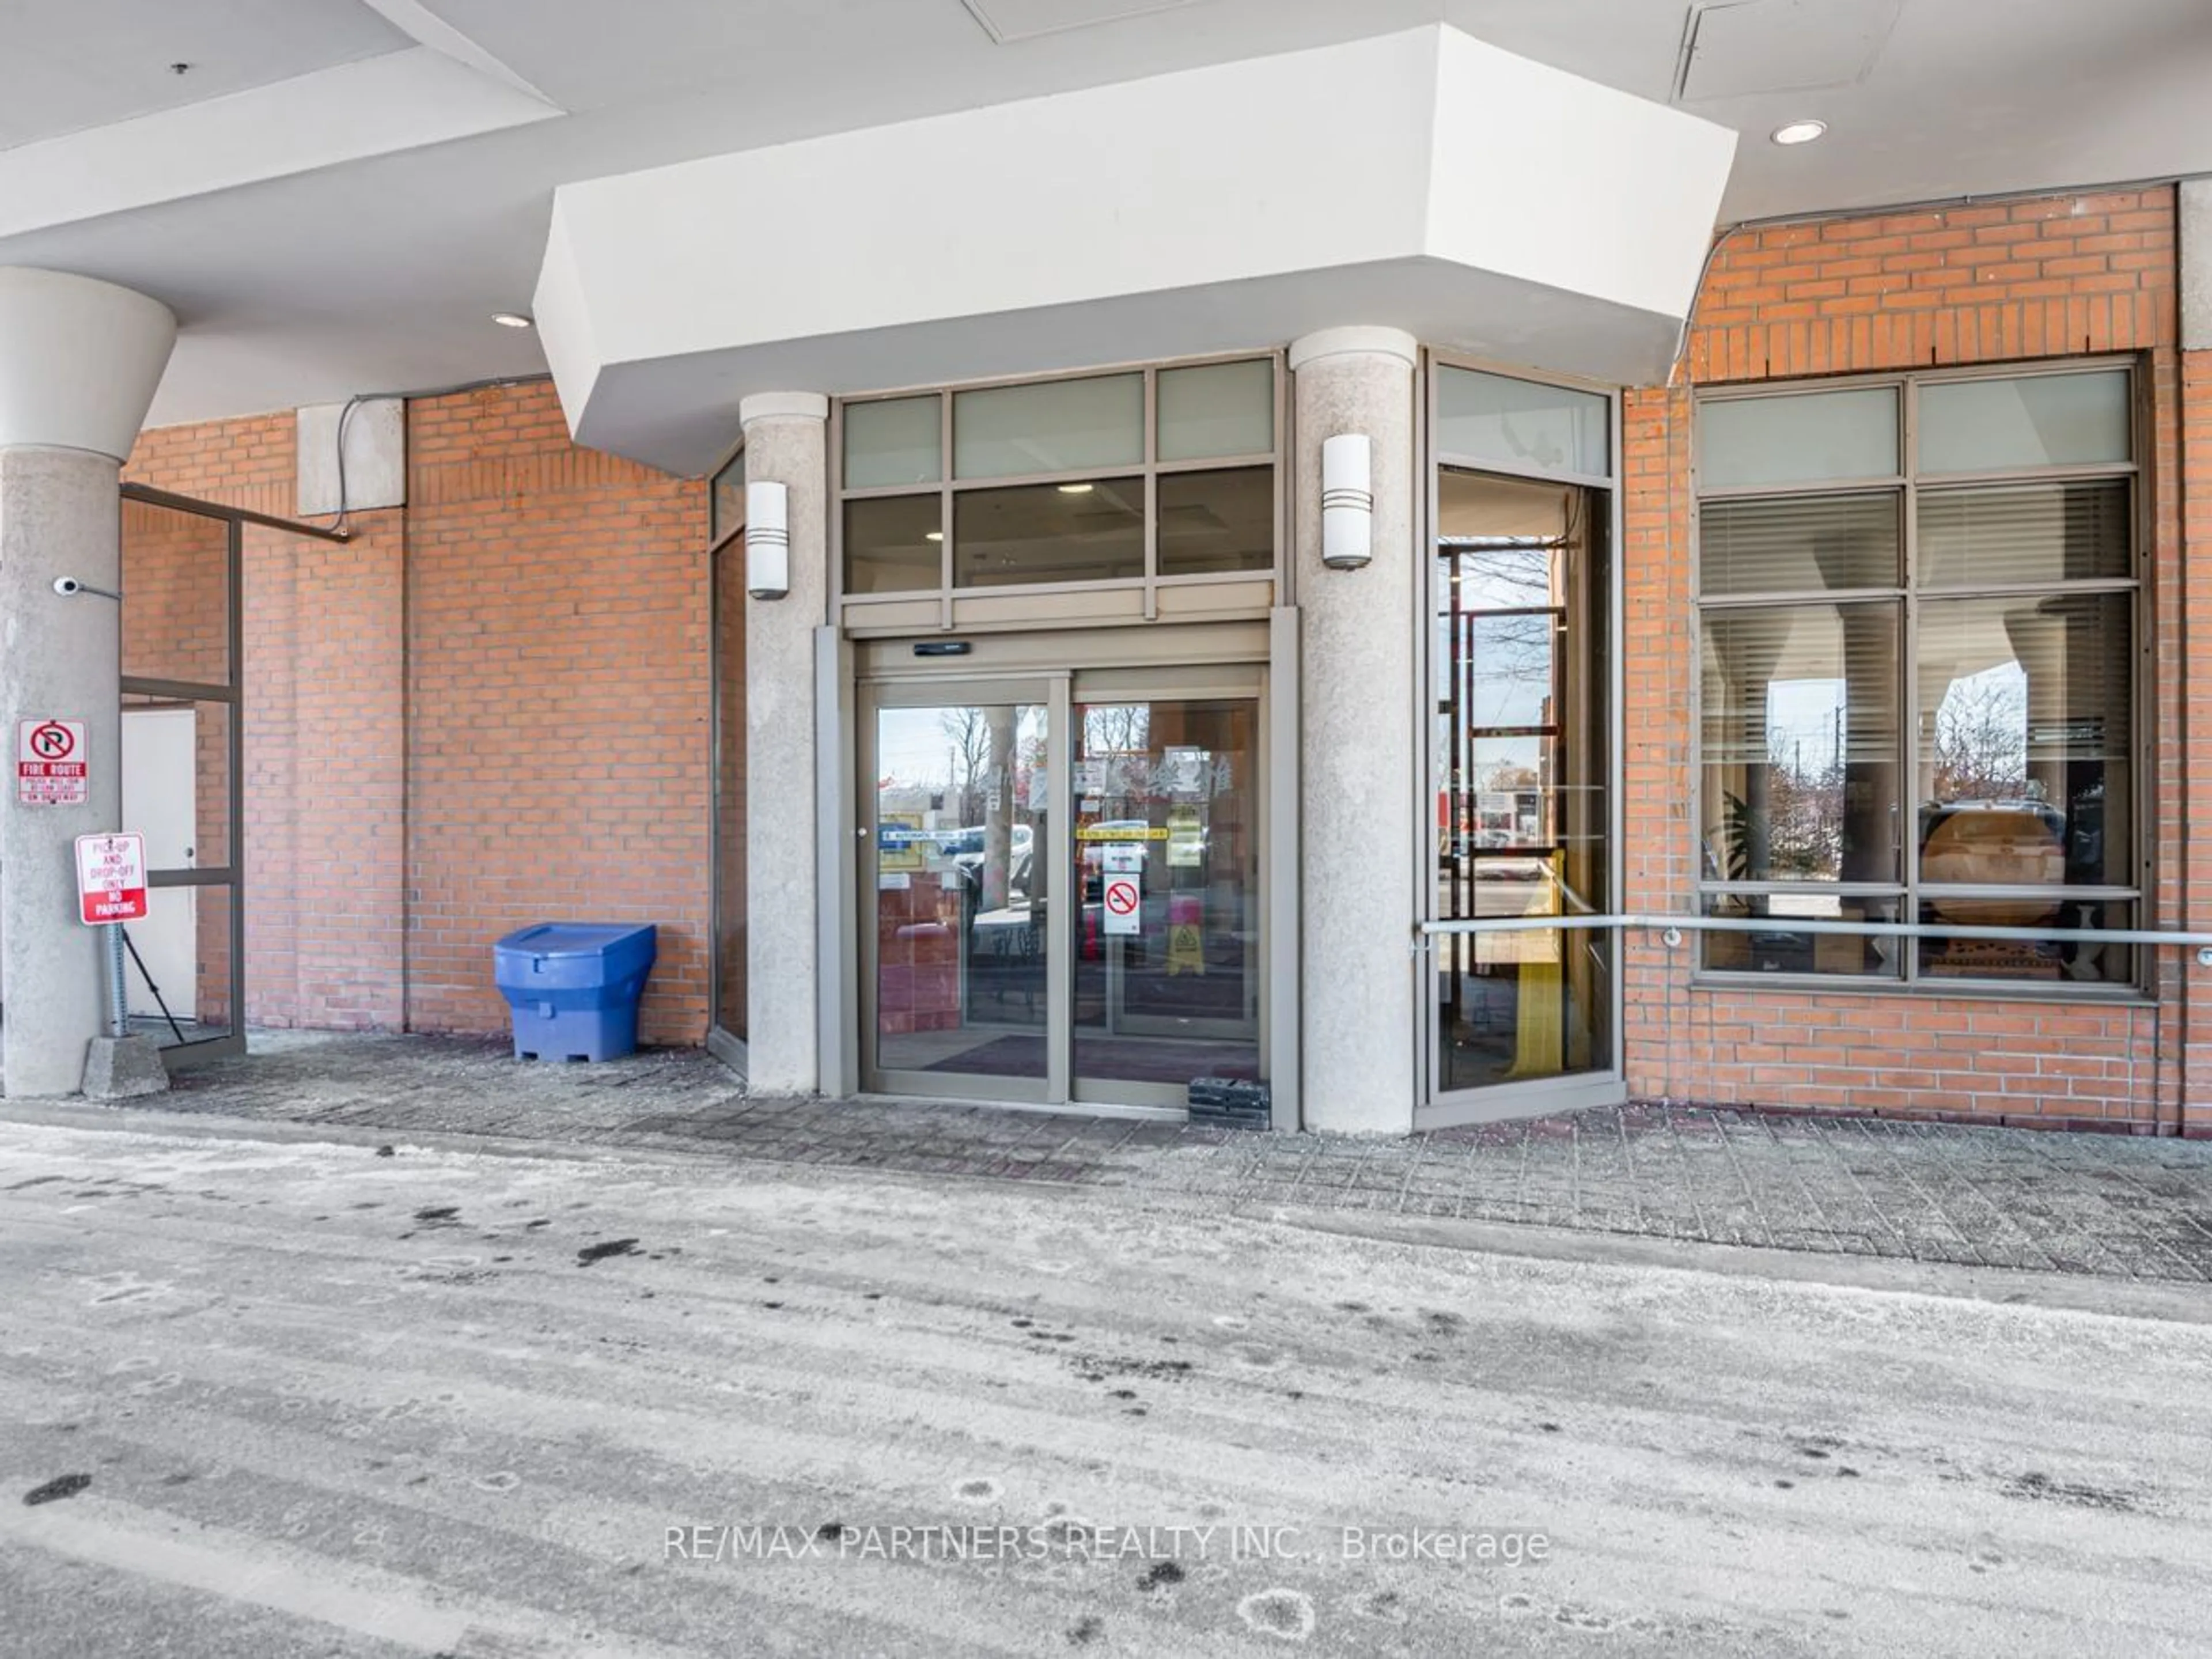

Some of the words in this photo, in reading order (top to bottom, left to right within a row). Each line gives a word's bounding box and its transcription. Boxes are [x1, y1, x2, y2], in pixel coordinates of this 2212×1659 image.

[23, 763, 44, 775] FIRE
[50, 763, 81, 775] ROUTE
[93, 840, 130, 854] PICK-UP
[103, 854, 123, 865] AND
[90, 865, 134, 879] DROP-OFF
[102, 879, 124, 891] ONLY
[108, 891, 123, 903] NO
[95, 901, 136, 916] PARKING
